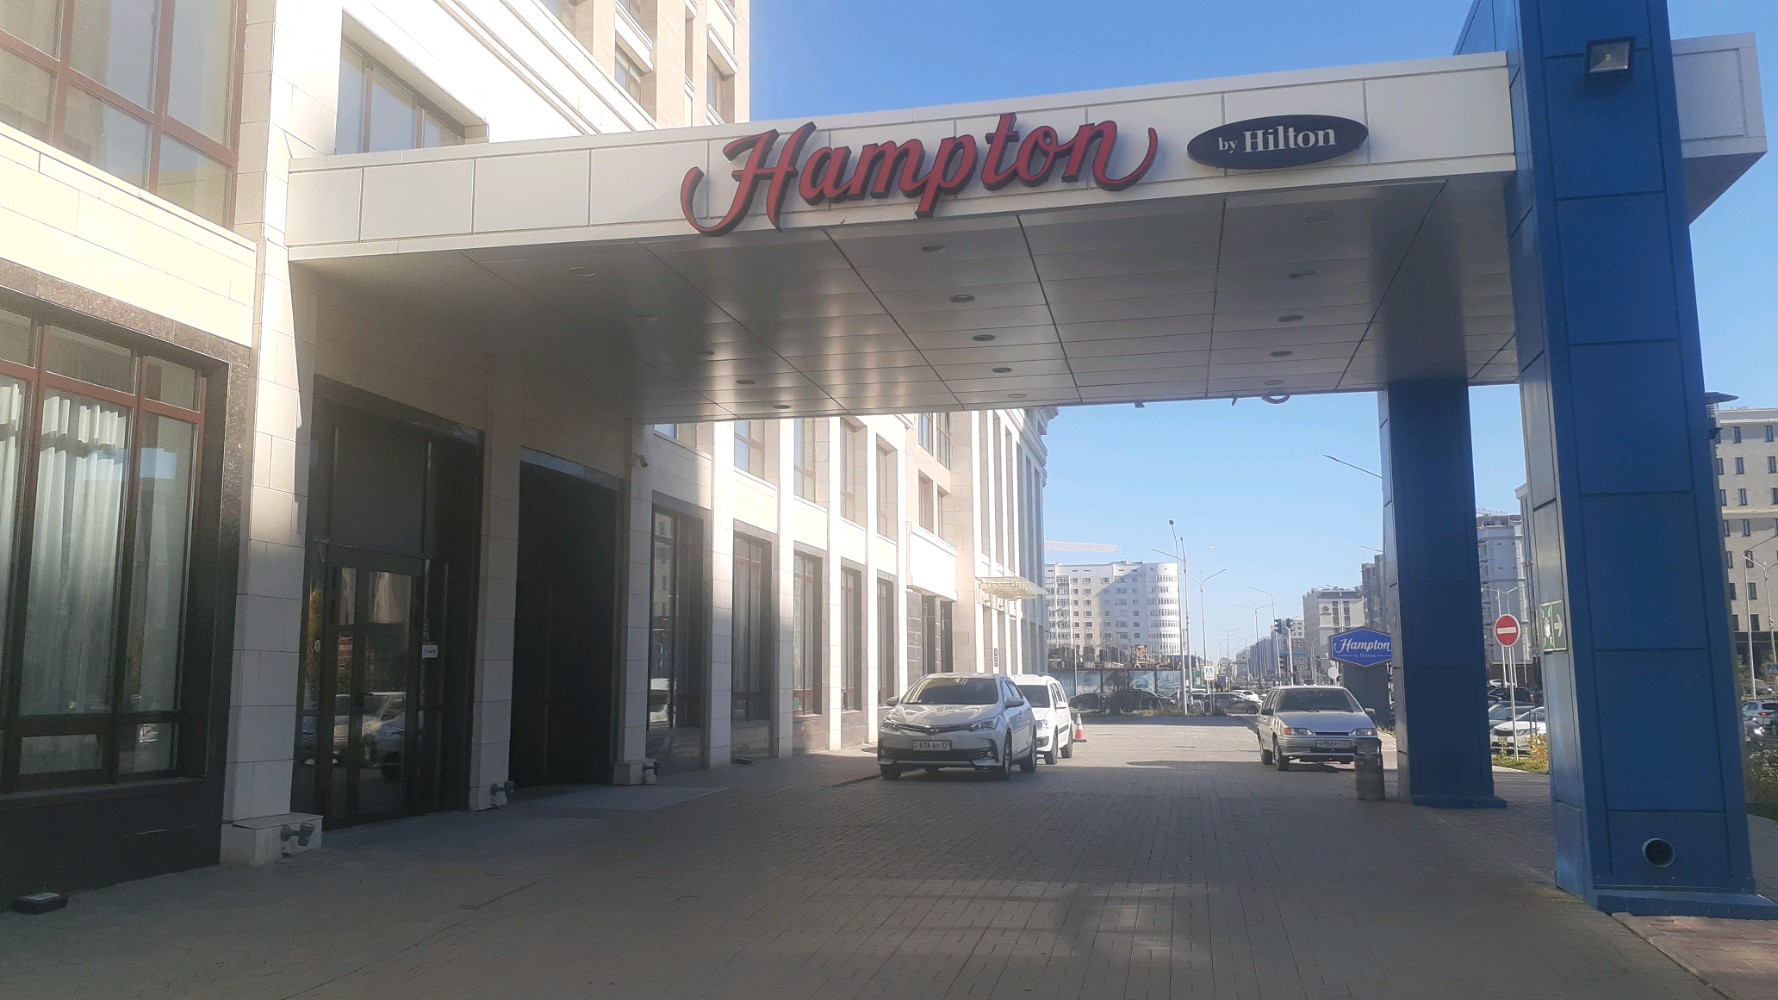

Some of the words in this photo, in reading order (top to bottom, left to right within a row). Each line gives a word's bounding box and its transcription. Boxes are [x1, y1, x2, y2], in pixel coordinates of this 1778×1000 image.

[1218, 137, 1238, 154] by
[1242, 125, 1337, 153] Hilton
[681, 111, 1159, 237] Hampton
[1333, 638, 1392, 653] Hampton
